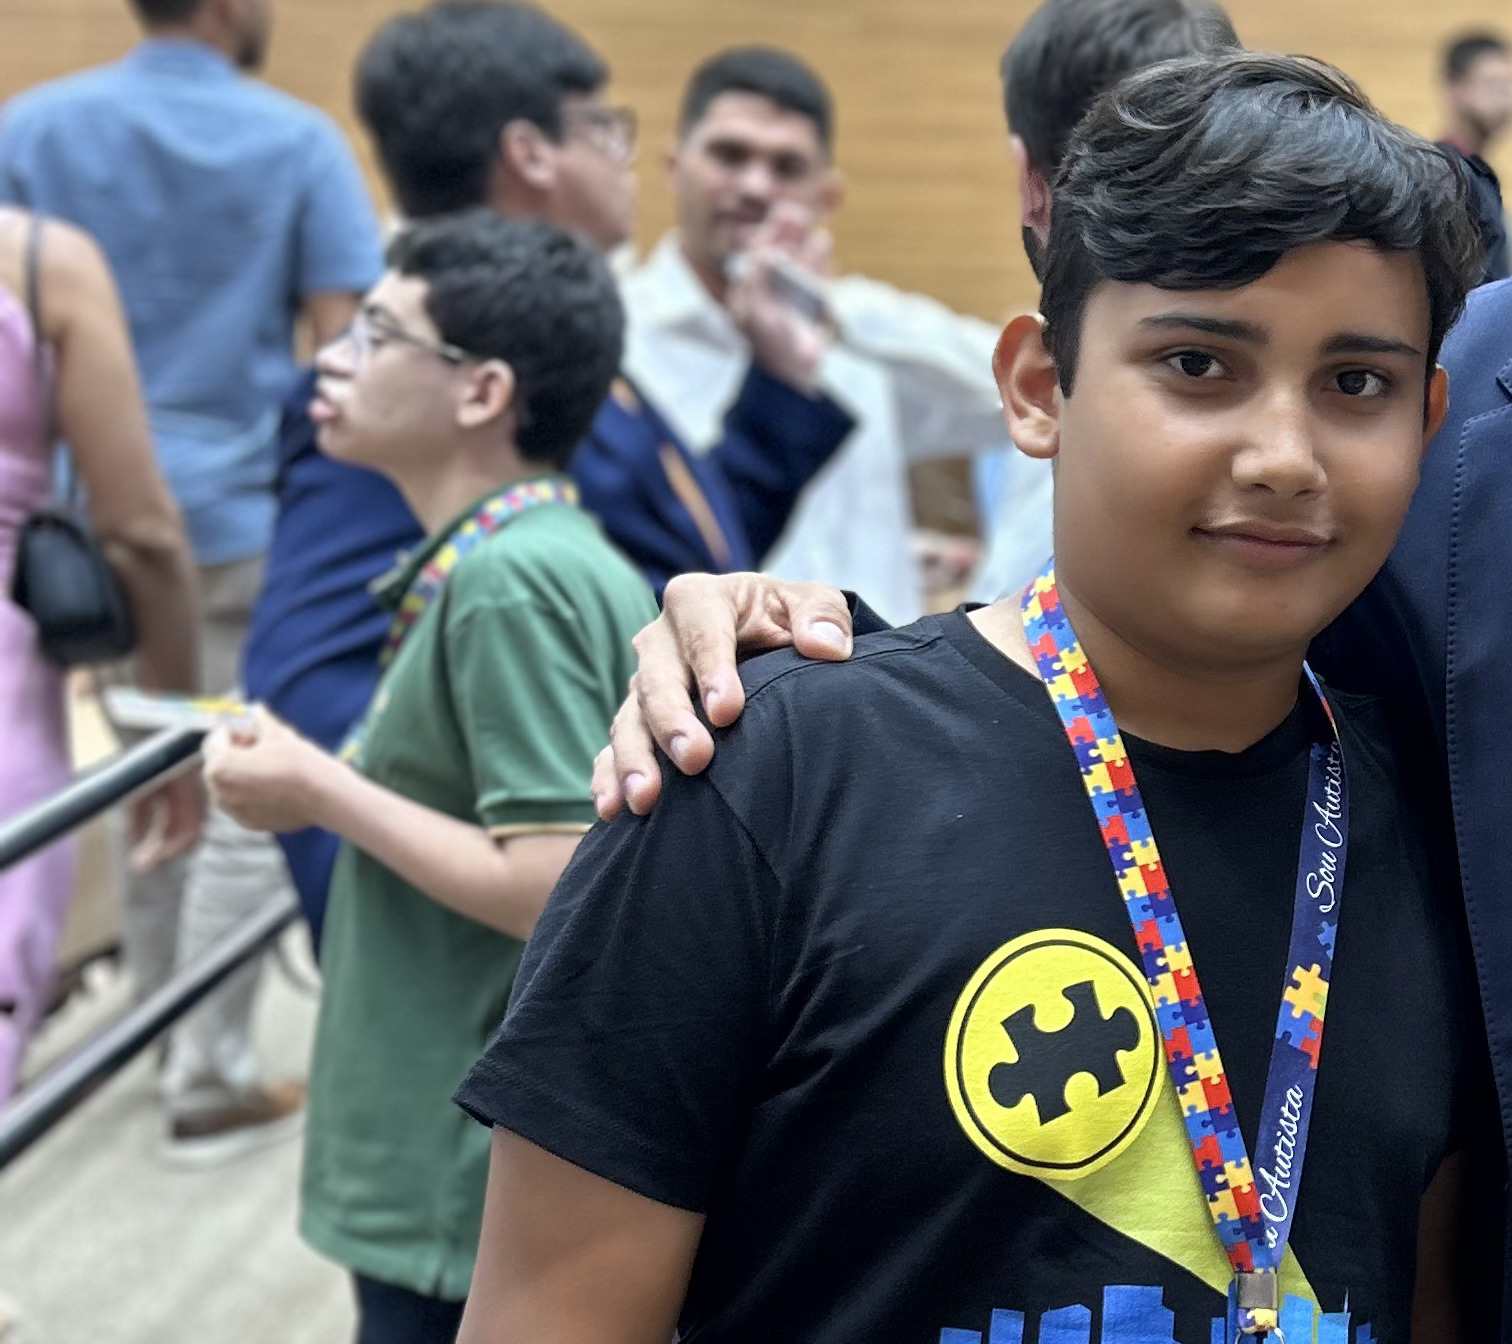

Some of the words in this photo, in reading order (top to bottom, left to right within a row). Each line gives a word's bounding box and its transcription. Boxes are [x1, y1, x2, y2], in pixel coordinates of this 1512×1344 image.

[1312, 741, 1344, 848] Autista
[1306, 850, 1336, 913] Sou
[1259, 1084, 1304, 1222] Autista
